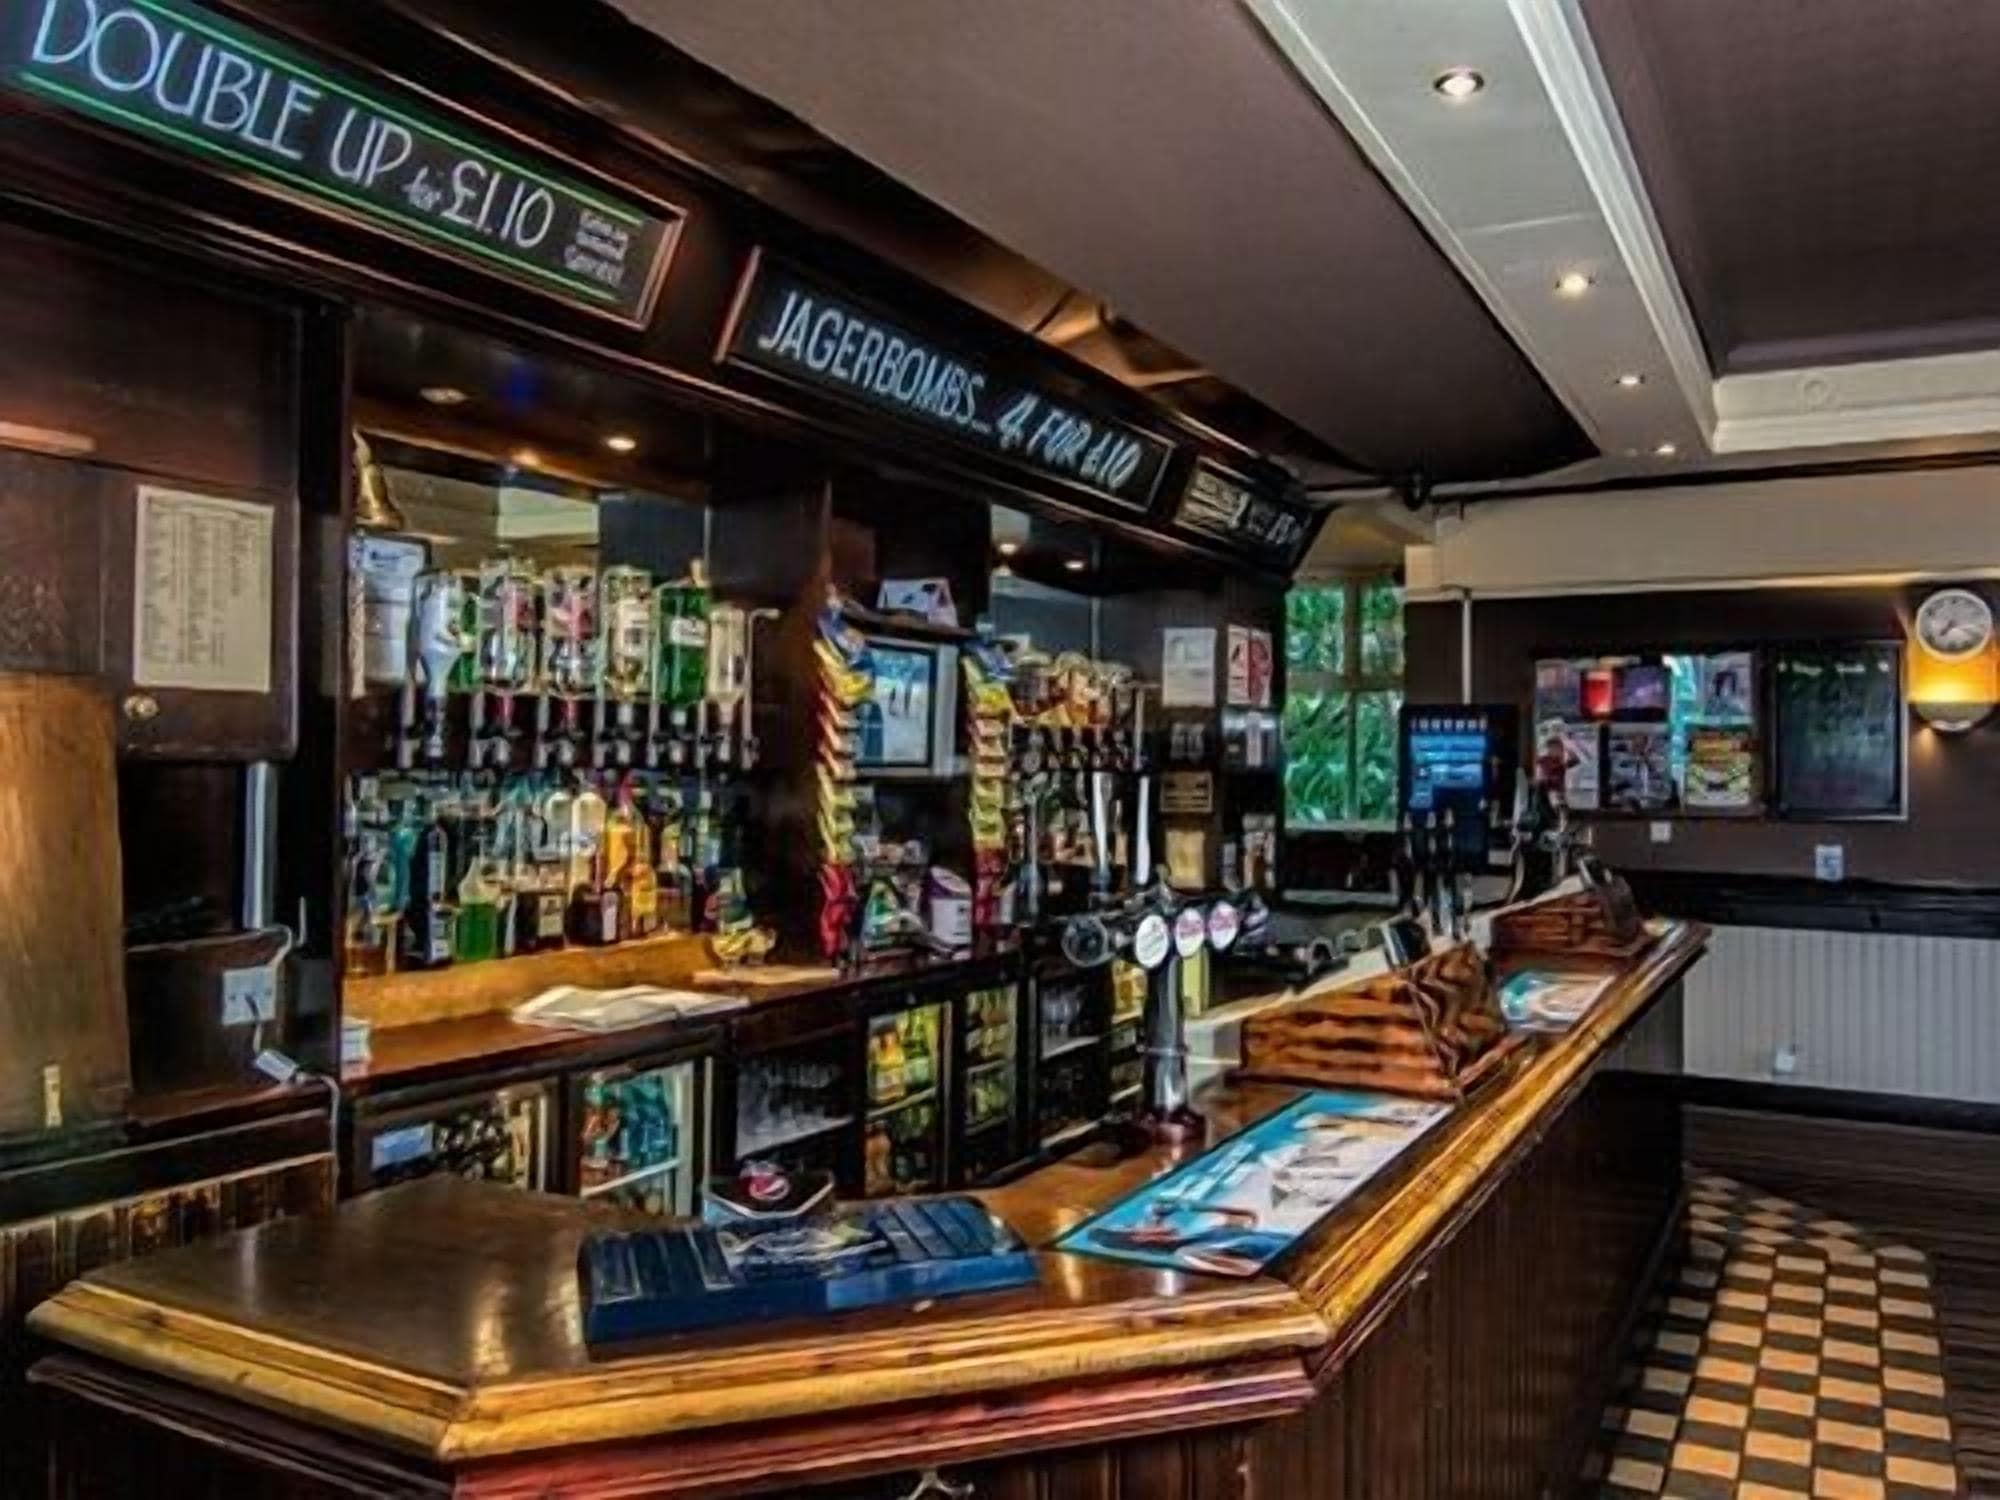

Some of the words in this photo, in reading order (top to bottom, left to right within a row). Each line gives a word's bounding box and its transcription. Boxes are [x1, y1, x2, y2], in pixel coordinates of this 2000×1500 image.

[31, 0, 323, 160] DOUBLE
[328, 105, 413, 188] UP
[440, 159, 556, 248] £1.10
[997, 393, 1041, 450] 4
[1026, 408, 1093, 468] FOR
